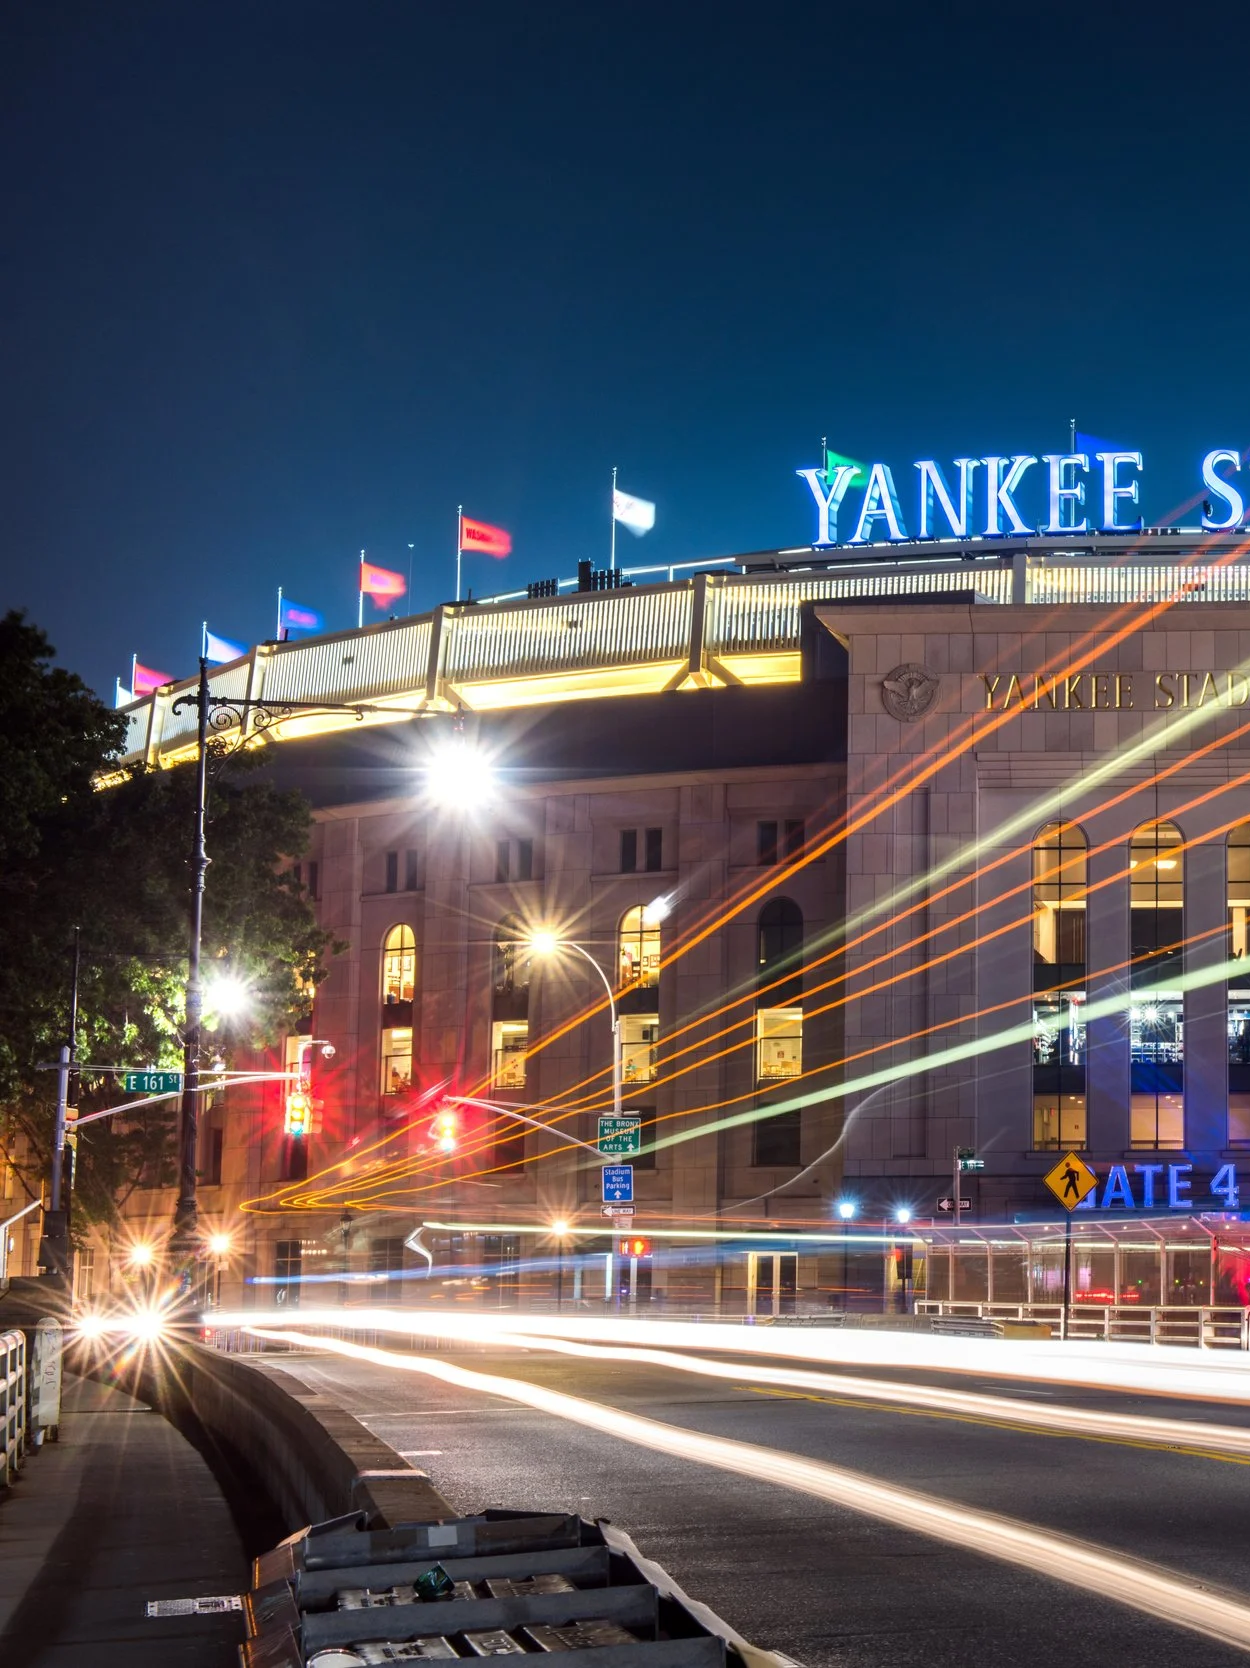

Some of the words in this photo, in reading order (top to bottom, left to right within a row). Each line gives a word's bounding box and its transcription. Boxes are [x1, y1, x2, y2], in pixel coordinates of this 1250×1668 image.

[796, 451, 1144, 549] YANKEE
[976, 672, 1134, 710] YANKEE
[130, 1075, 137, 1090] E
[143, 1075, 164, 1090] 161
[616, 1120, 639, 1128] BRONX
[603, 1143, 622, 1151] ARTS
[612, 1175, 624, 1183] Bus
[606, 1182, 630, 1190] Parking
[1209, 1163, 1240, 1209] 4
